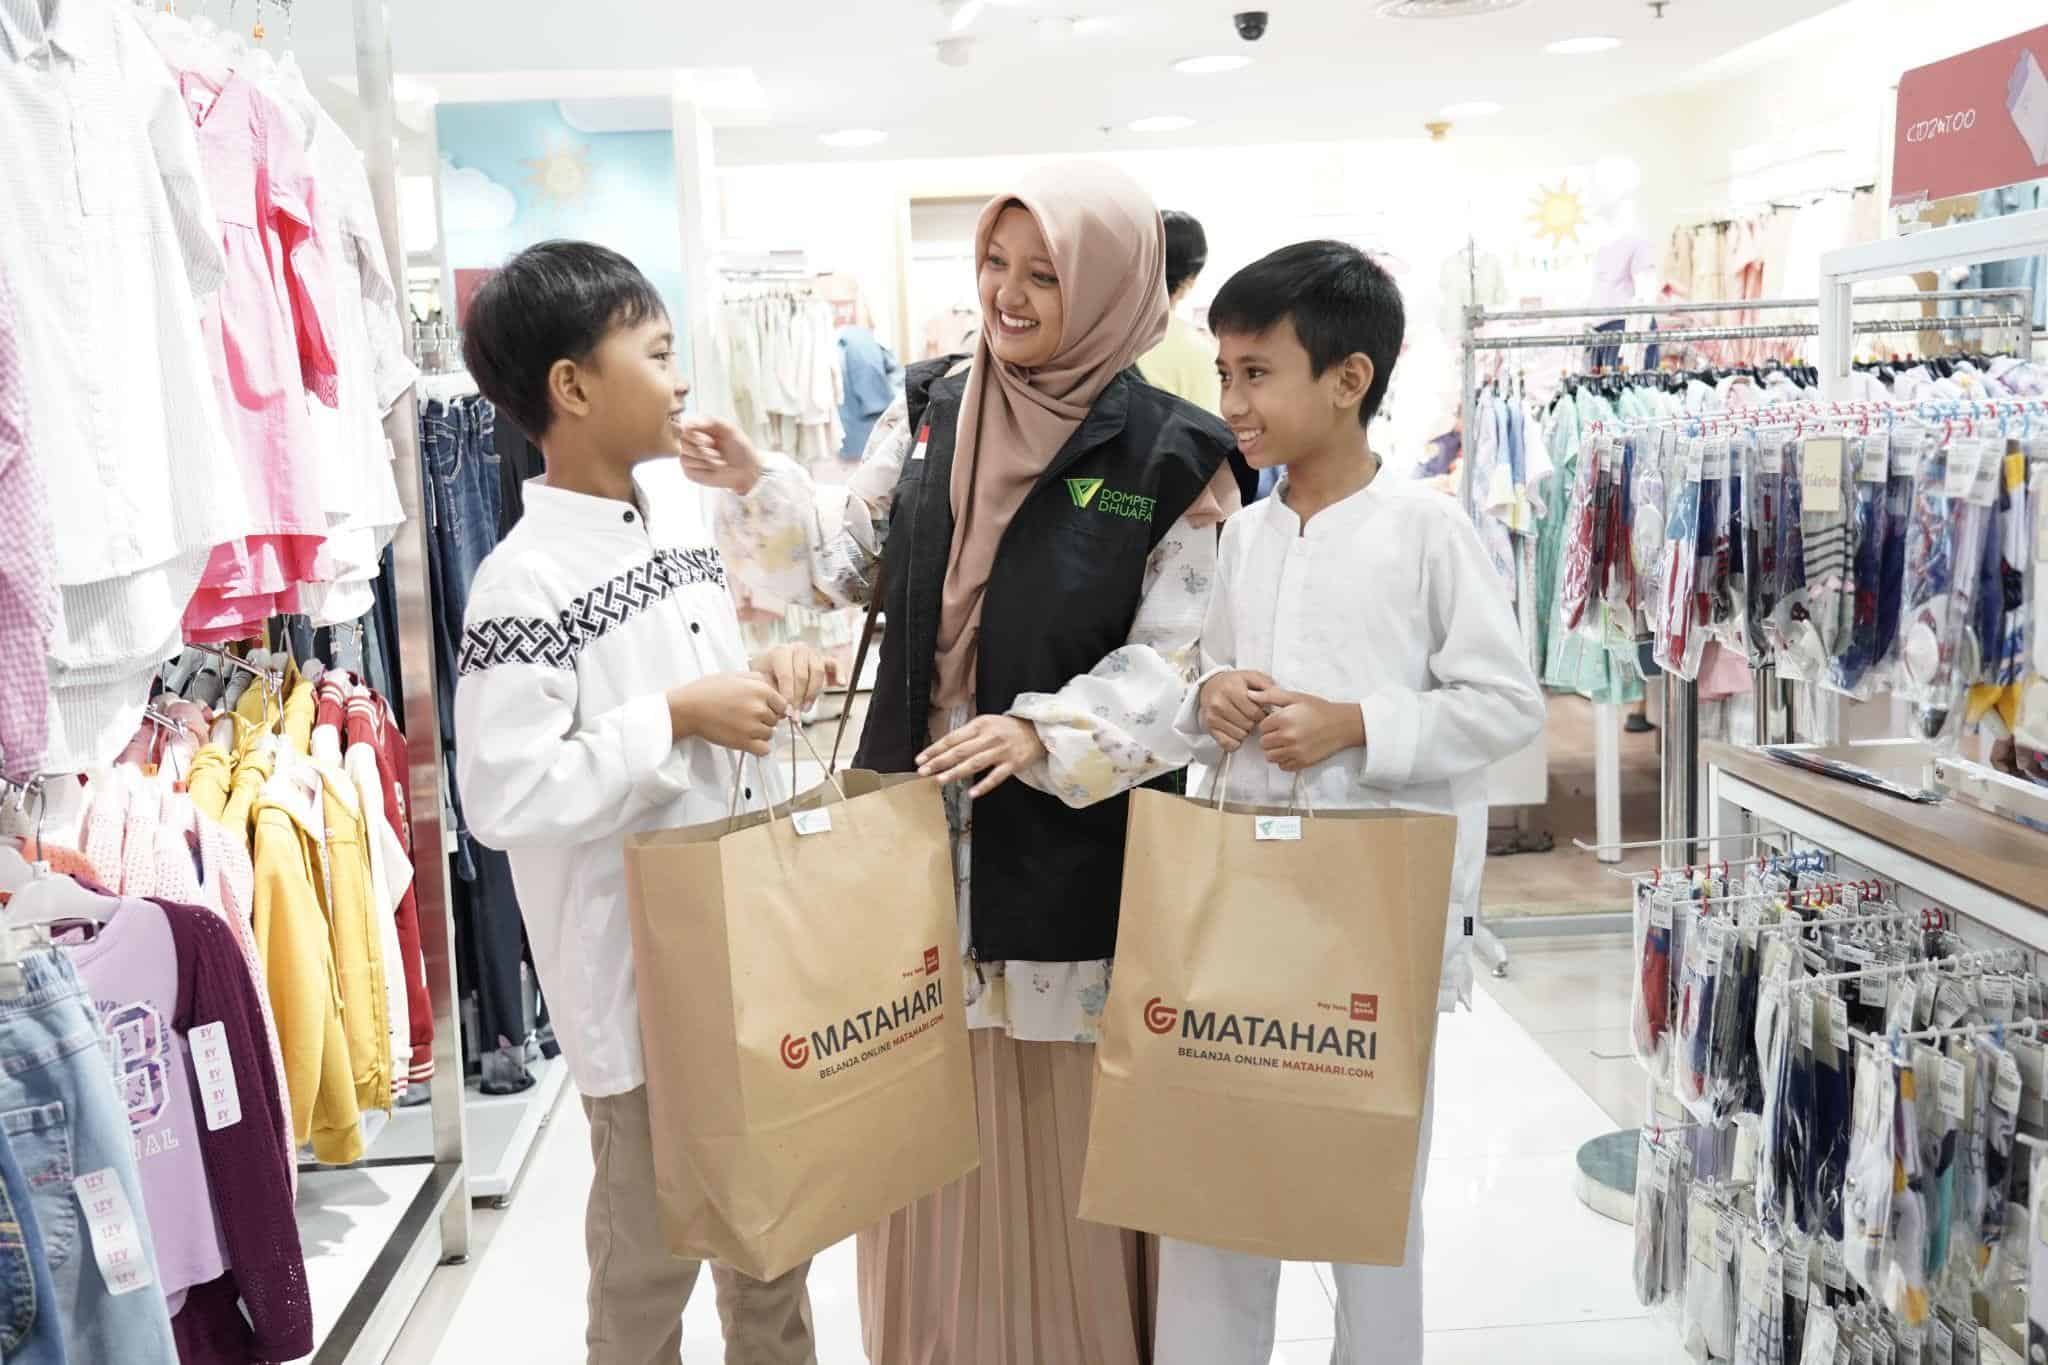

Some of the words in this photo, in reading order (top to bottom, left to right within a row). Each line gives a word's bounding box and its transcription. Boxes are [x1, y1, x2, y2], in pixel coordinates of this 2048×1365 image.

[1098, 500, 1152, 522] DHUAFA
[1101, 488, 1157, 511] DOMPET
[810, 978, 943, 1060] MATAHARI
[1181, 1008, 1377, 1061] MATAHARI
[819, 1056, 860, 1079] BELANJA
[861, 1041, 892, 1062] ONLINE
[1177, 1046, 1231, 1063] BELANJA
[1234, 1053, 1280, 1068] ONLINE
[1281, 1059, 1375, 1080] MATAHARI.COM
